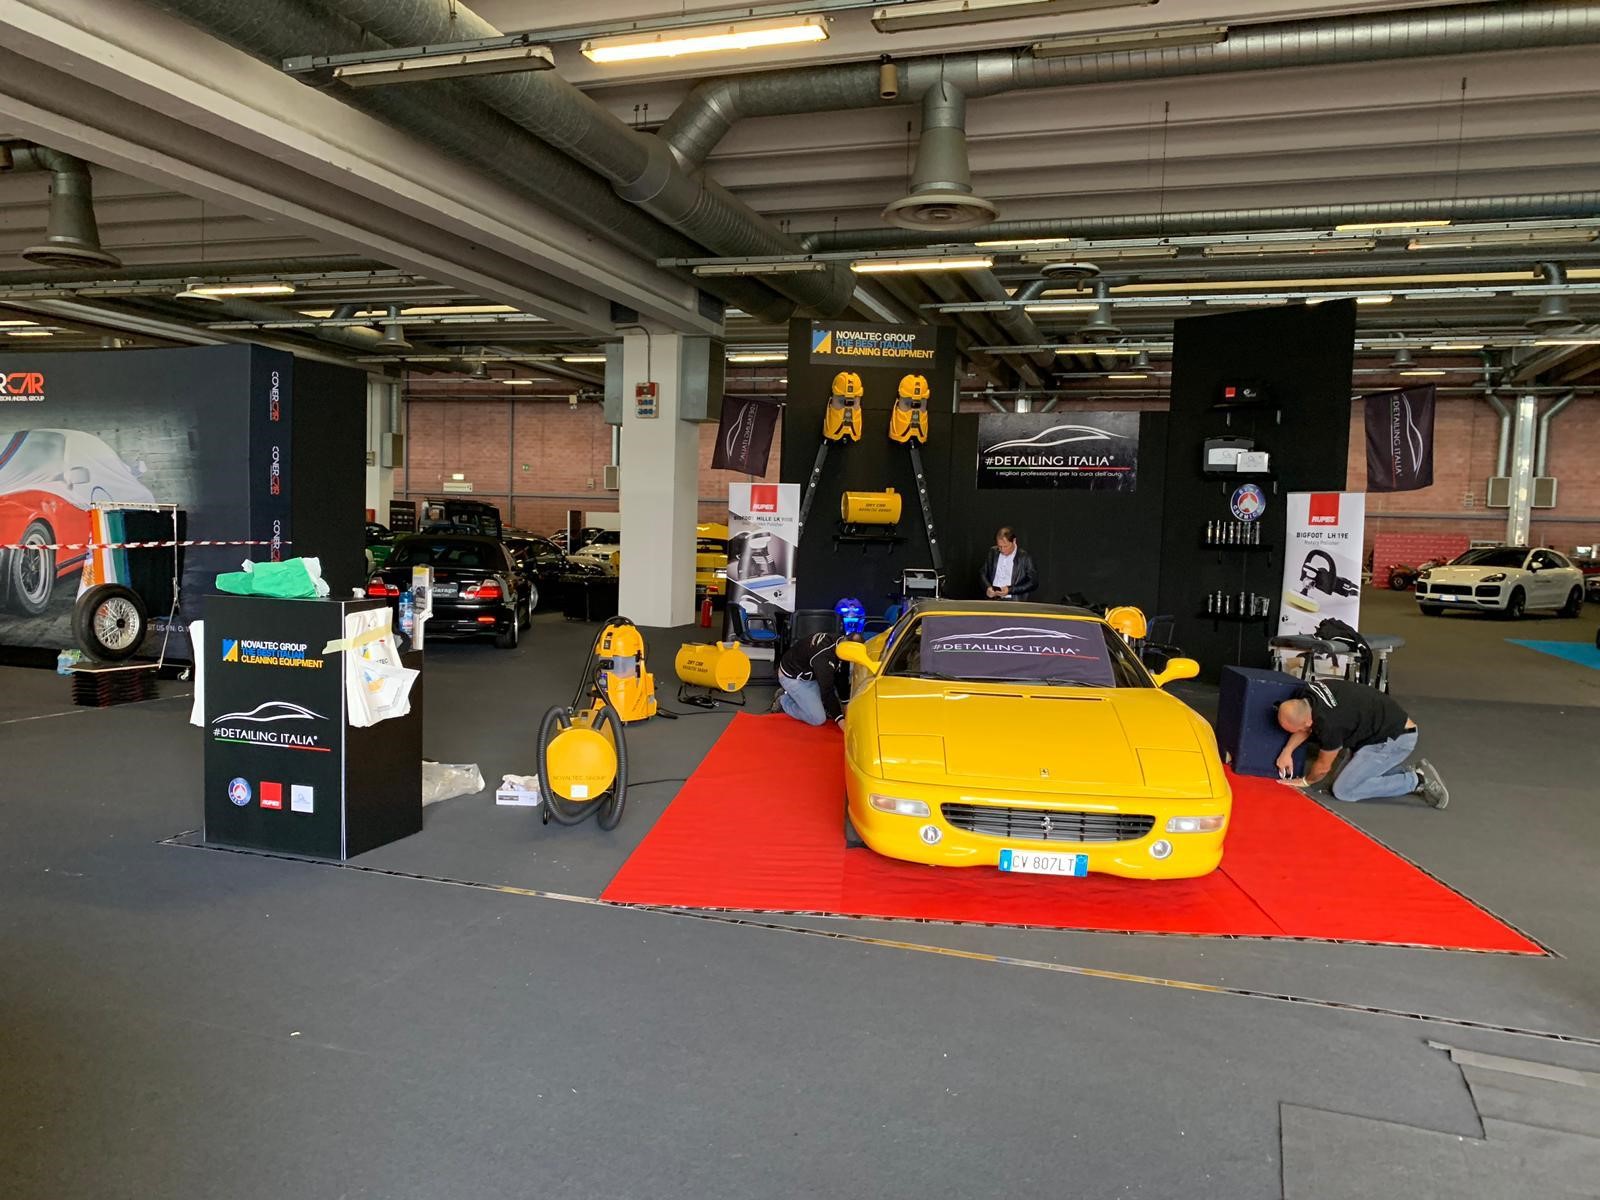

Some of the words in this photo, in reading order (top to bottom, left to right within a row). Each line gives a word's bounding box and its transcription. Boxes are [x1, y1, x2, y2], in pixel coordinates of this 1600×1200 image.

[836, 331, 881, 341] NOVALTEC
[883, 333, 916, 342] GROUP
[837, 339, 853, 347] THE
[855, 340, 877, 348] BEST
[880, 341, 913, 350] ITALIAN
[836, 346, 881, 356] CLEANING
[882, 348, 935, 359] EQUIPMENT
[985, 456, 1064, 465] #DETAILING
[241, 640, 279, 650] NOVALTEC
[280, 642, 307, 652] GROUP
[932, 643, 1024, 652] #DETAILING
[242, 648, 256, 656] THE
[258, 649, 275, 657] BEST
[277, 650, 305, 659] ITALIAN
[241, 655, 278, 665] CLEANING
[280, 658, 324, 669] EQUIPMENT
[213, 728, 278, 743] #DETAILING
[1013, 855, 1029, 868] CV
[1033, 857, 1074, 872] 807LT
